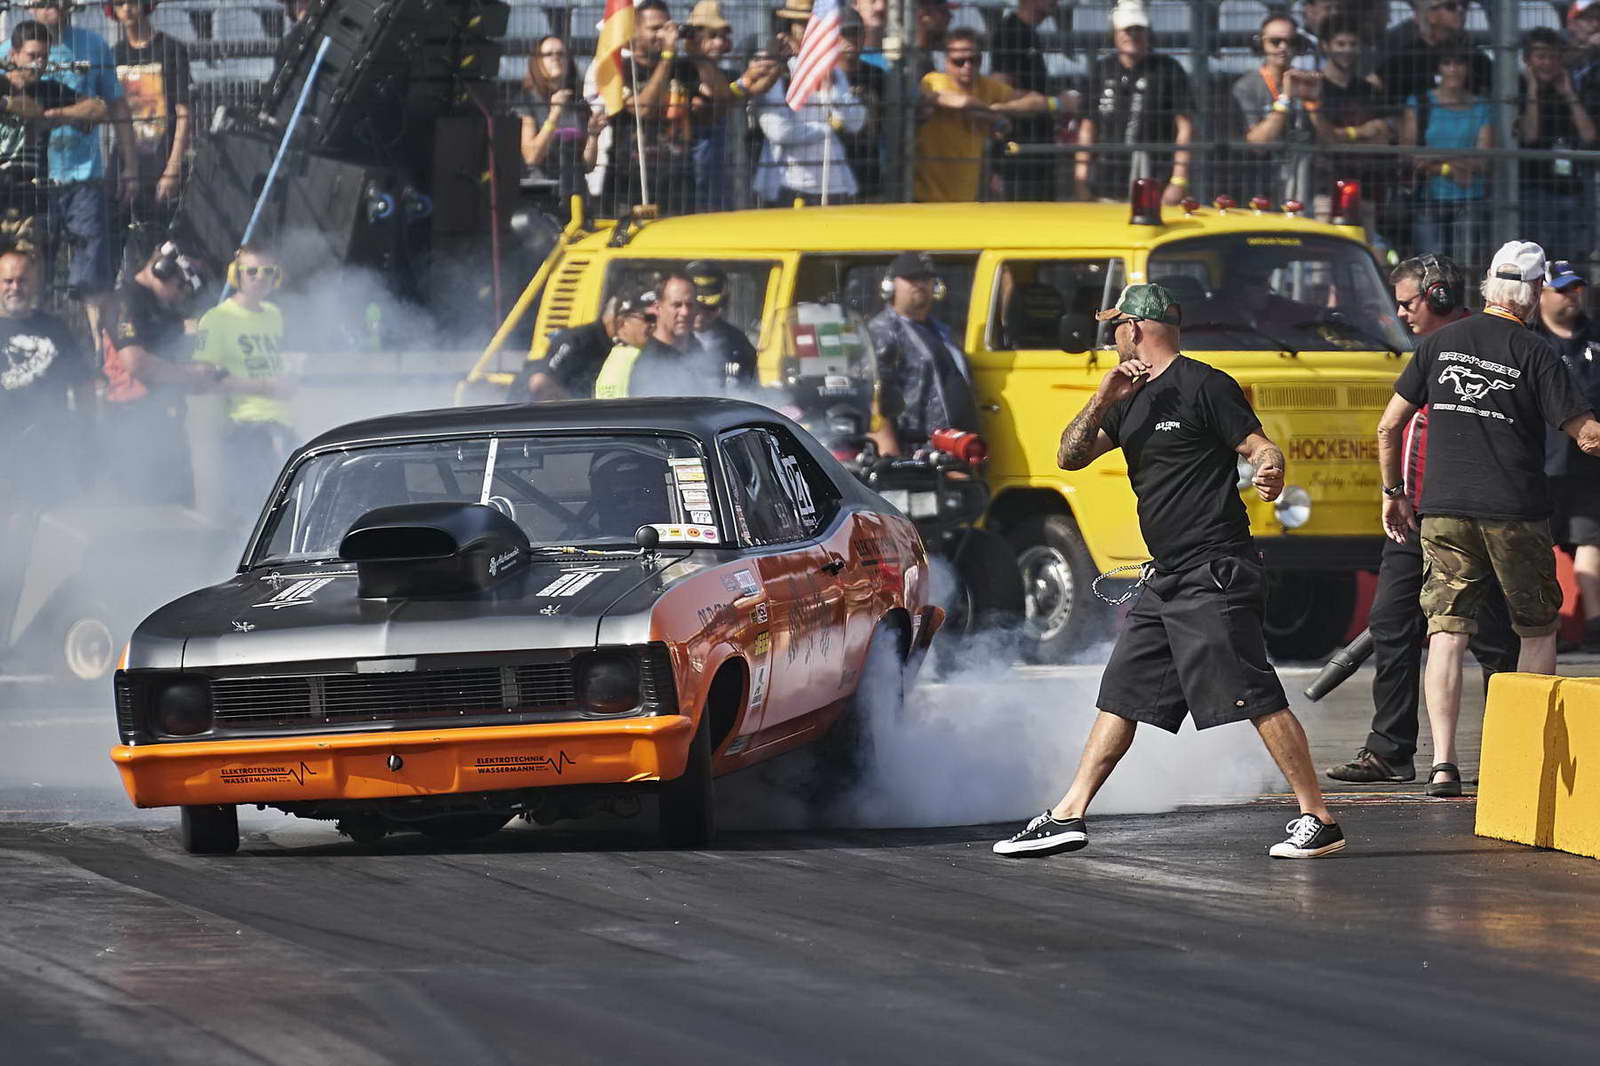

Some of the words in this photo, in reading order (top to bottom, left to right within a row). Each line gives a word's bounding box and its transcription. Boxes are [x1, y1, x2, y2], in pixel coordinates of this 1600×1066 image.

[476, 756, 545, 764] ELEKTROTECHNIK
[221, 767, 287, 775] ELEKTROTECHNIK
[478, 766, 535, 774] WASSERMANN
